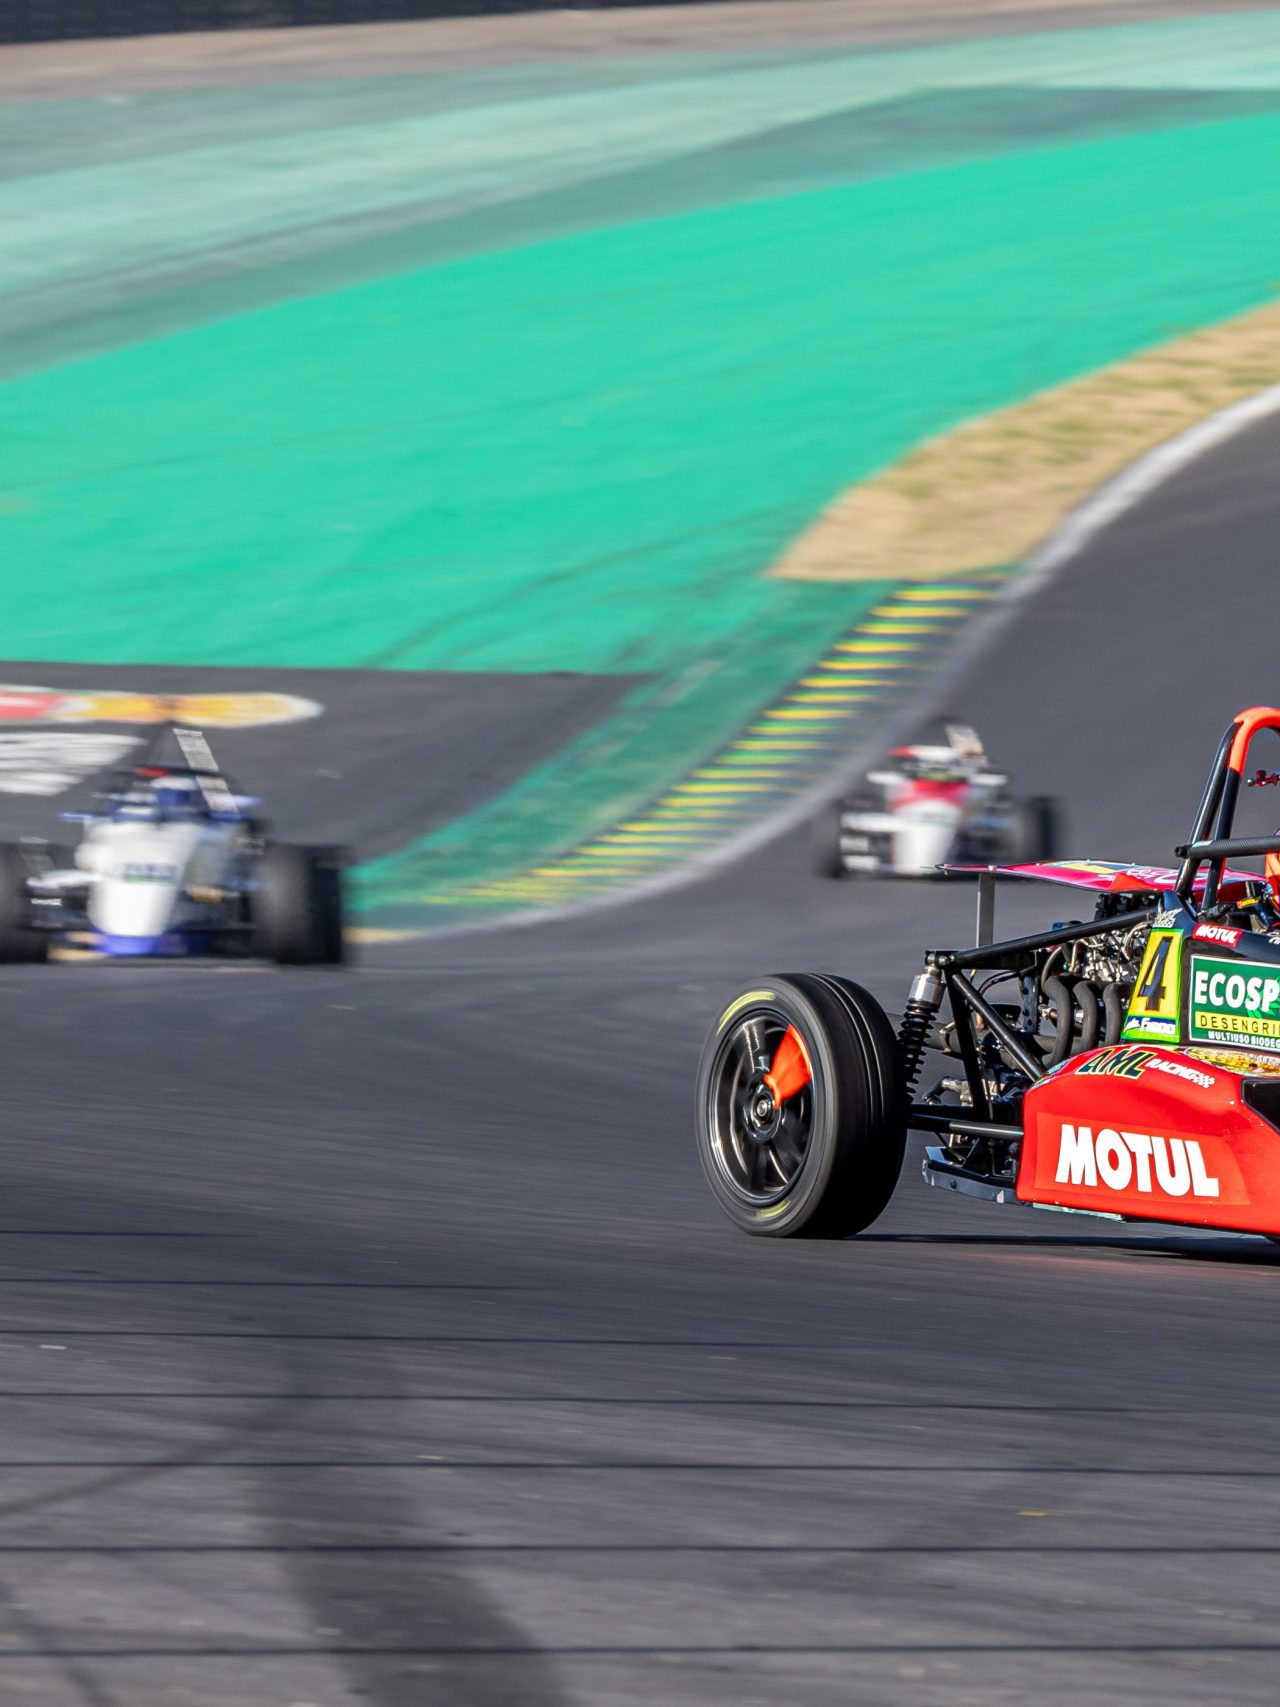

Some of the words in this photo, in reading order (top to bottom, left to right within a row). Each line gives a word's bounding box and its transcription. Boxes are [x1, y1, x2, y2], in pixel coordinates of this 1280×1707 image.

[1195, 925, 1239, 943] MOTUL
[1137, 936, 1174, 1011] 4
[1208, 1031, 1250, 1043] MULTIUSO
[1075, 1048, 1156, 1080] AML
[1145, 1058, 1199, 1083] RACING
[1055, 1123, 1219, 1197] MOTUL
